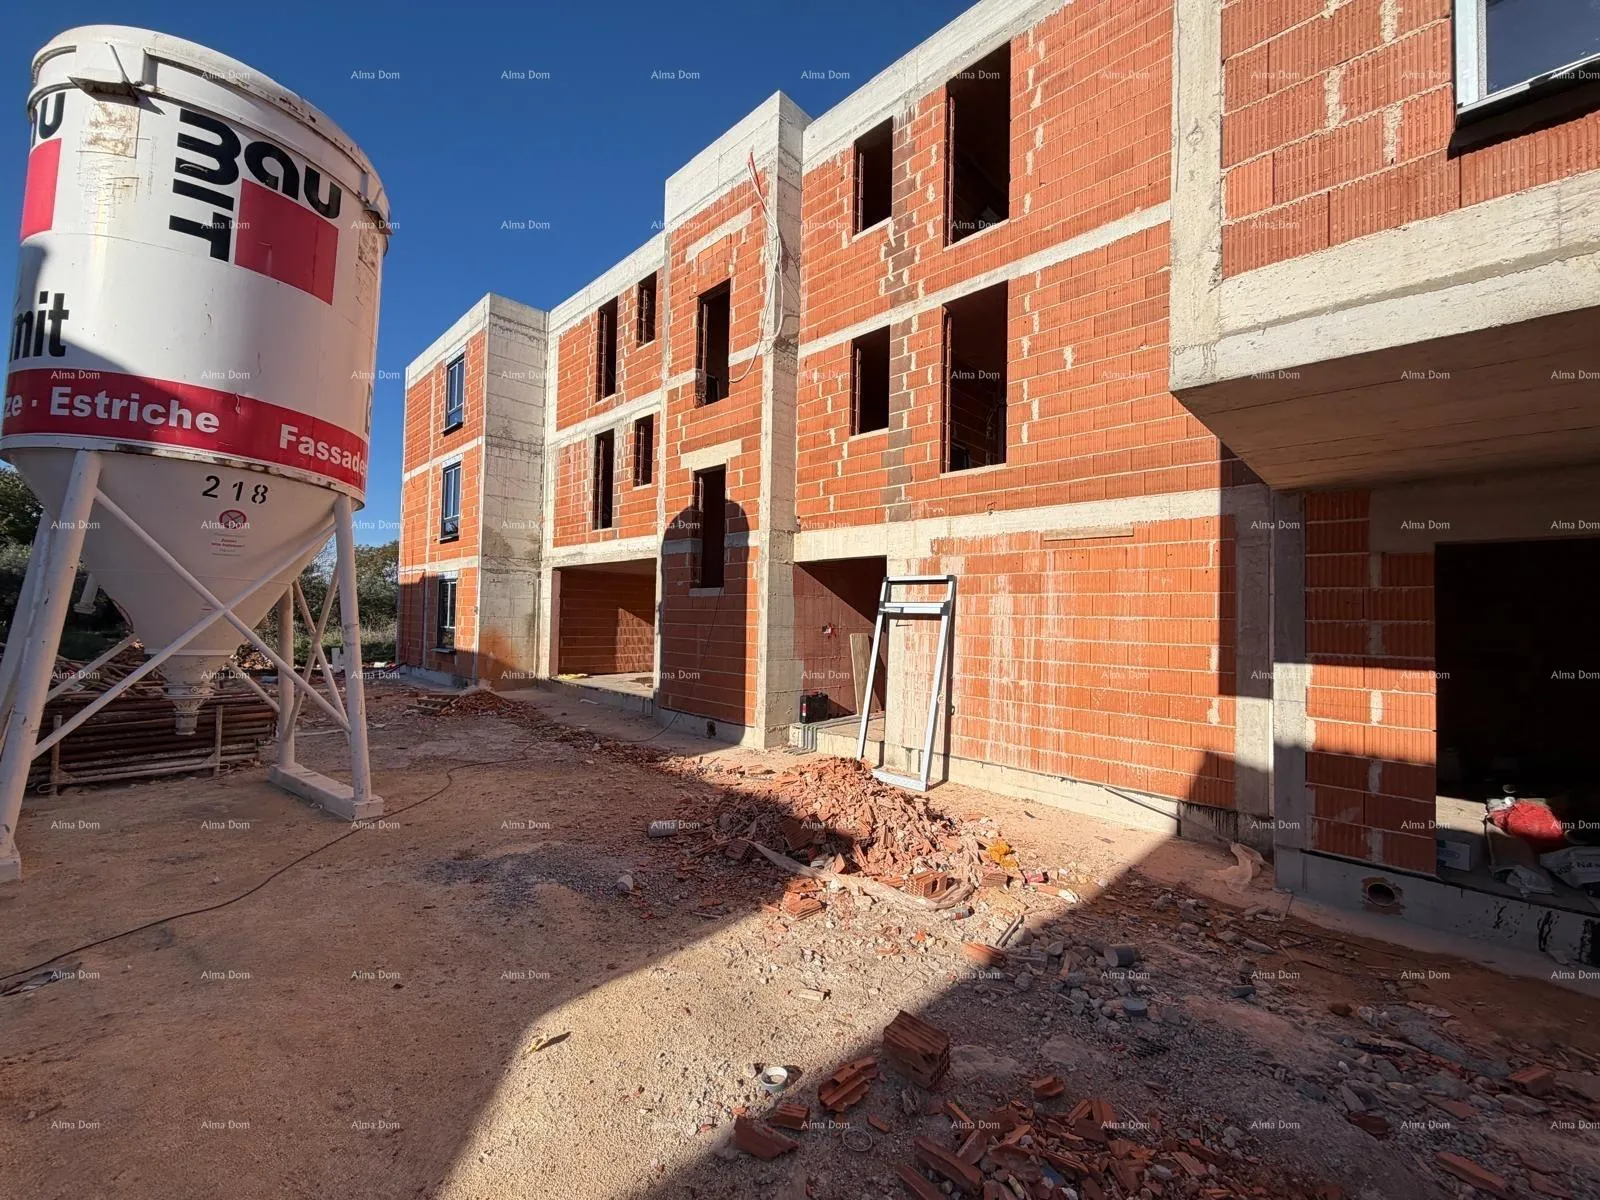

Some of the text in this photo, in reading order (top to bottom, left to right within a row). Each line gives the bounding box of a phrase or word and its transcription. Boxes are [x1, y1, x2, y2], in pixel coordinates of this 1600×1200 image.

[50, 386, 220, 434] Estriche
[280, 423, 367, 476] Fassade
[202, 475, 268, 505] 218
